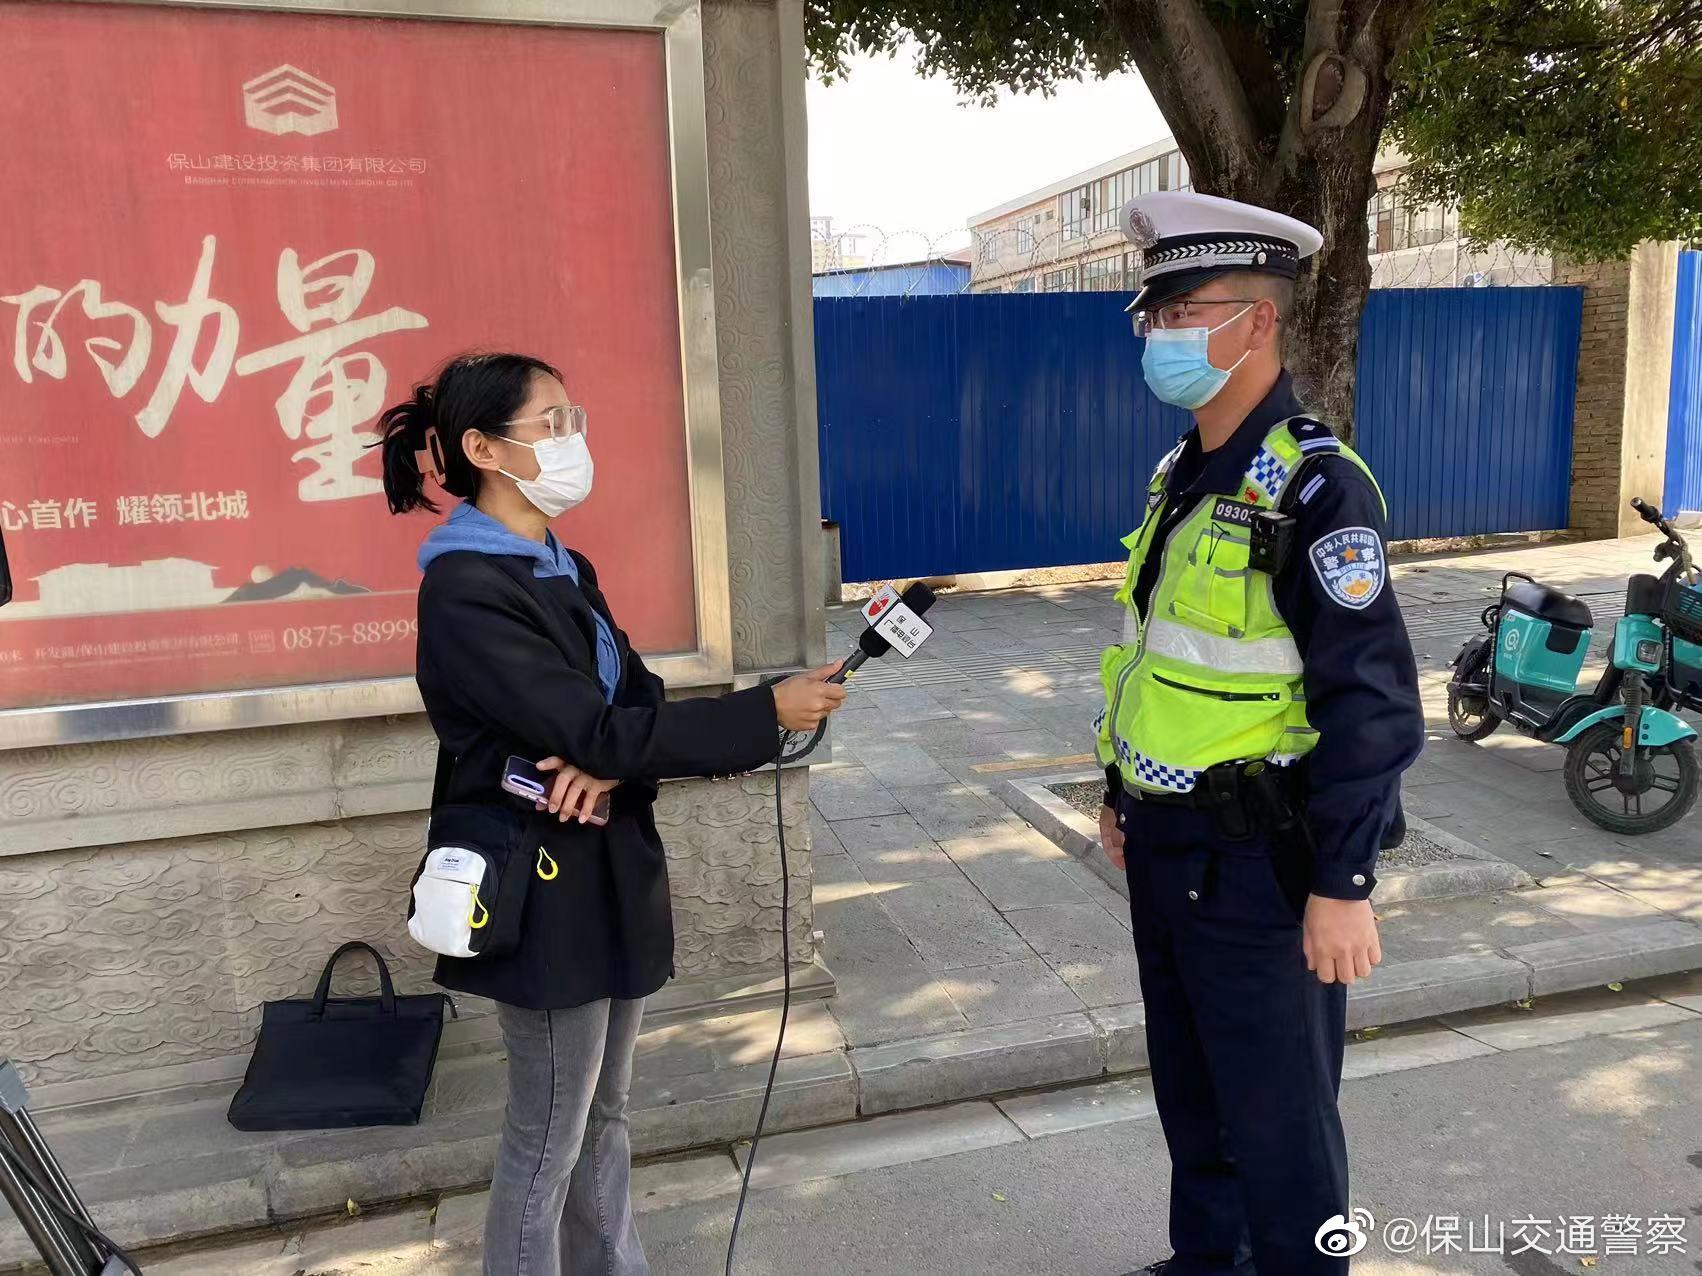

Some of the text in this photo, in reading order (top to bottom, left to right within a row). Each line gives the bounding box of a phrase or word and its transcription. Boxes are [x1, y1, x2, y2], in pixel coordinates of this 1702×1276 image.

[166, 153, 427, 174] 保山建设投资集团有限公司
[0, 234, 429, 502] 的力量
[116, 490, 250, 526] 耀领北城
[1316, 532, 1375, 558] 中华人民共和国
